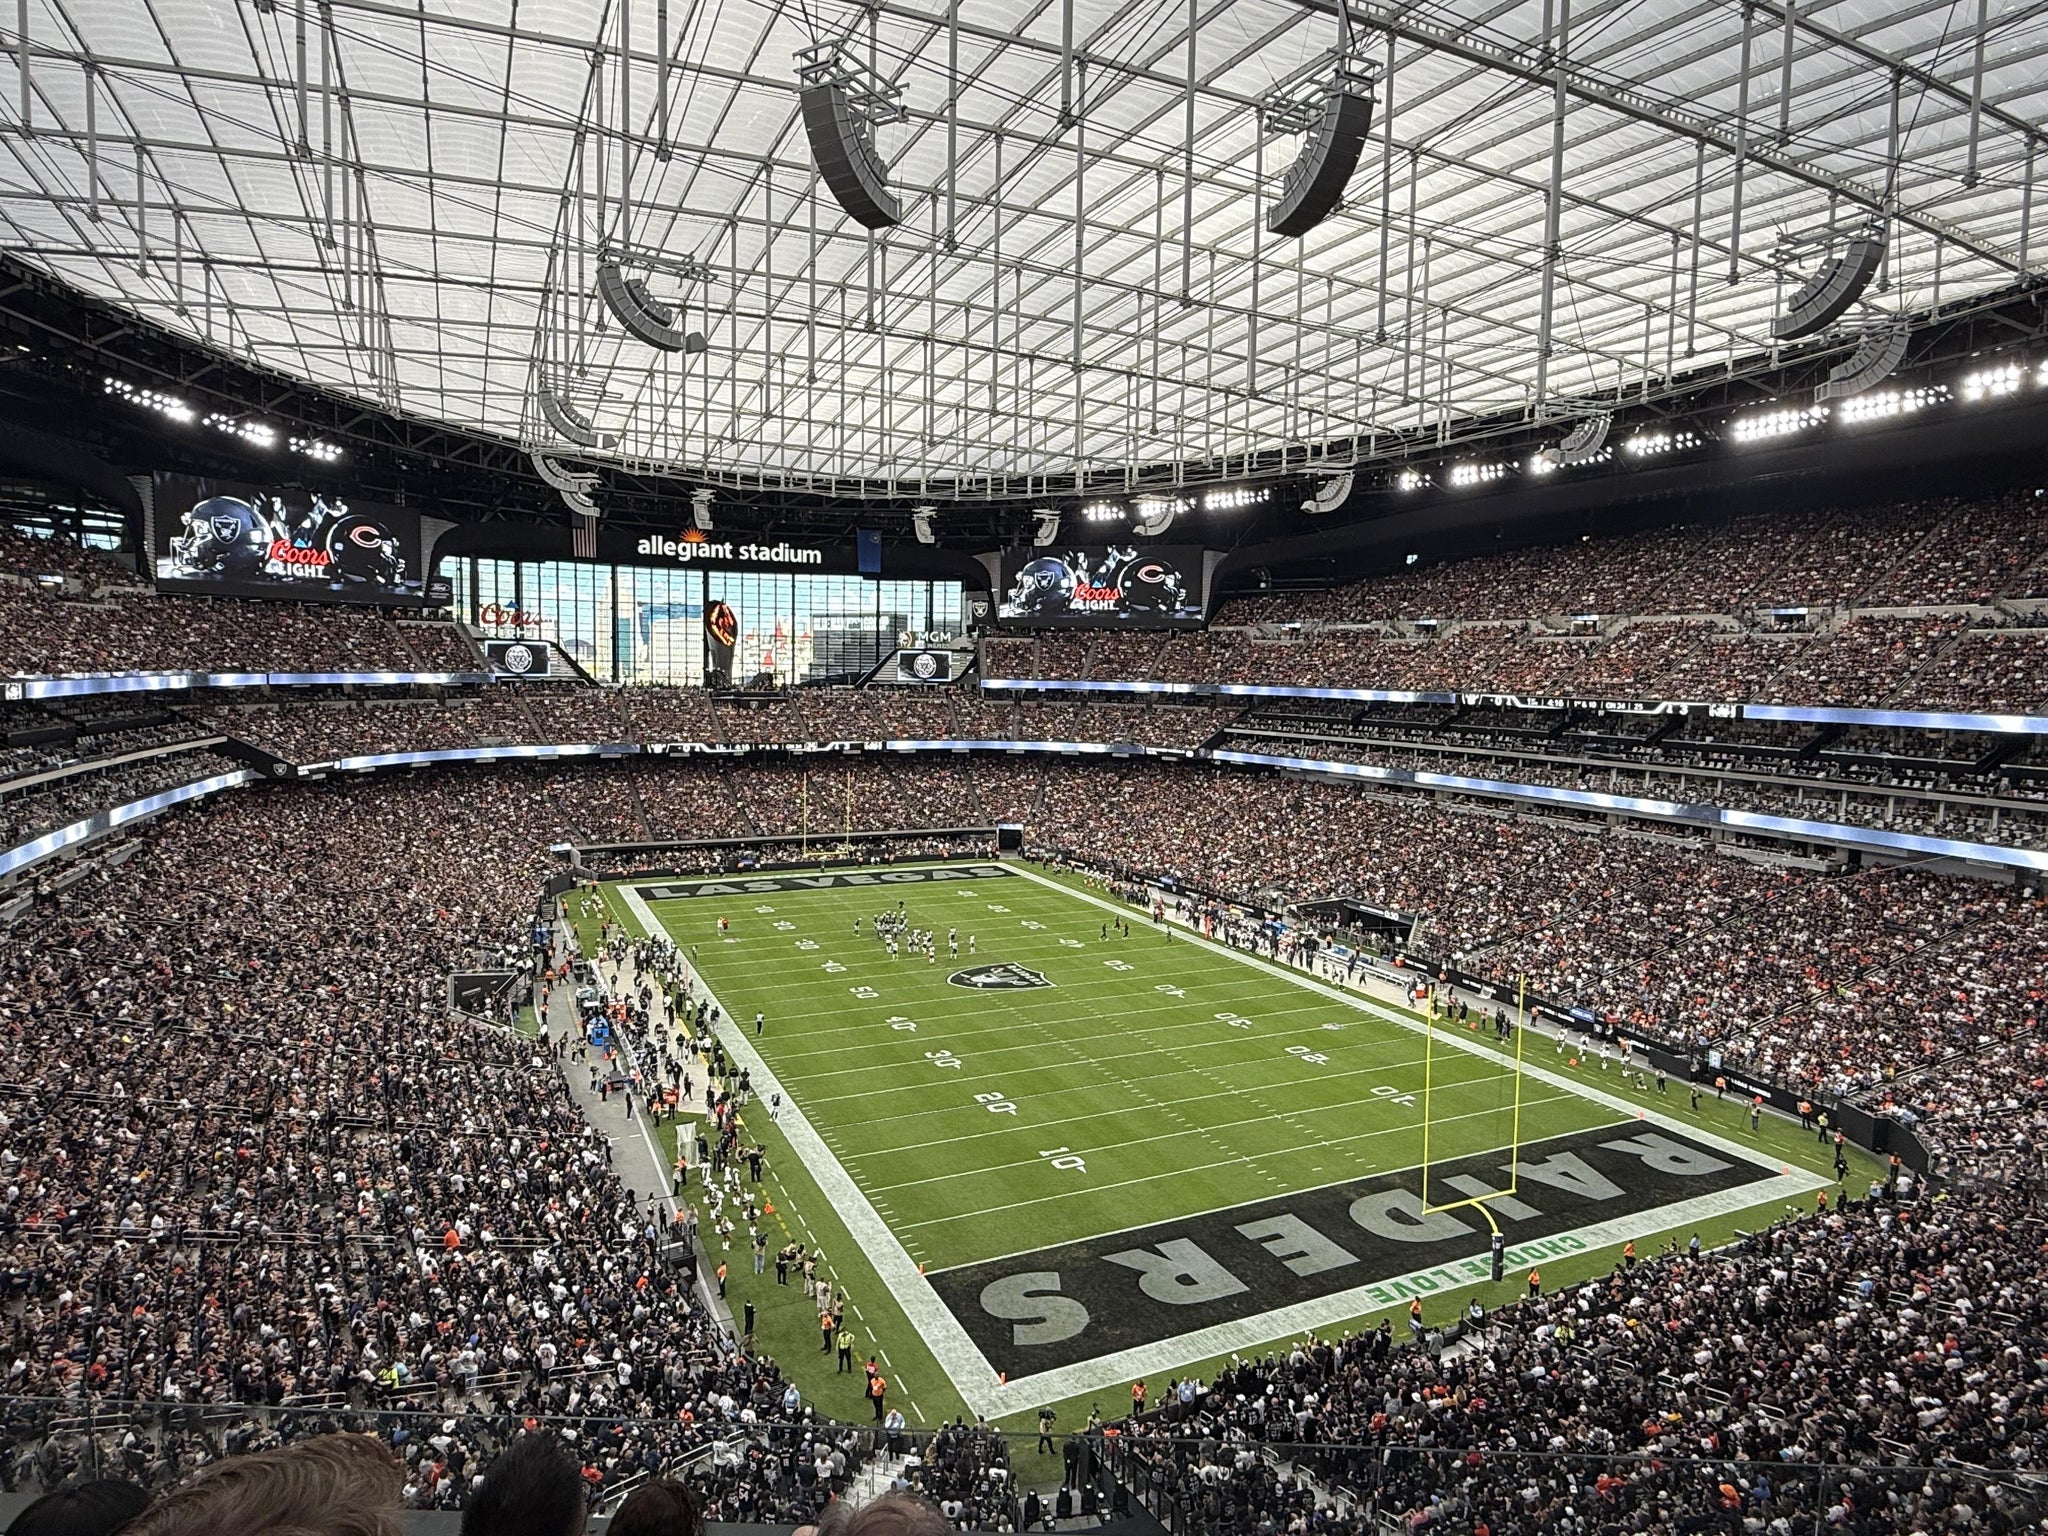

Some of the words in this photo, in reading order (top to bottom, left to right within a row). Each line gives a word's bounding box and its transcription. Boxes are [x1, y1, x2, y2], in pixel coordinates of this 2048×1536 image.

[272, 539, 330, 565] Coors
[637, 535, 733, 561] allegiant
[739, 543, 822, 564] stadium
[1074, 584, 1120, 600] Coors
[481, 602, 547, 626] Coors
[918, 631, 951, 642] MGM
[650, 880, 782, 899] LAS
[791, 867, 999, 888] VEGAS
[1103, 960, 1134, 971] 50
[849, 986, 879, 998] 50
[1154, 984, 1184, 997] 40
[885, 1016, 916, 1031] 40
[1213, 1012, 1252, 1028] 30
[925, 1050, 961, 1068] 30
[1284, 1045, 1329, 1064] 20
[973, 1091, 1017, 1113] 20
[1369, 1086, 1416, 1106] 10
[1039, 1147, 1086, 1171] 10
[980, 1133, 1734, 1346] RAIDERS
[1364, 1268, 1461, 1304] LOVE
